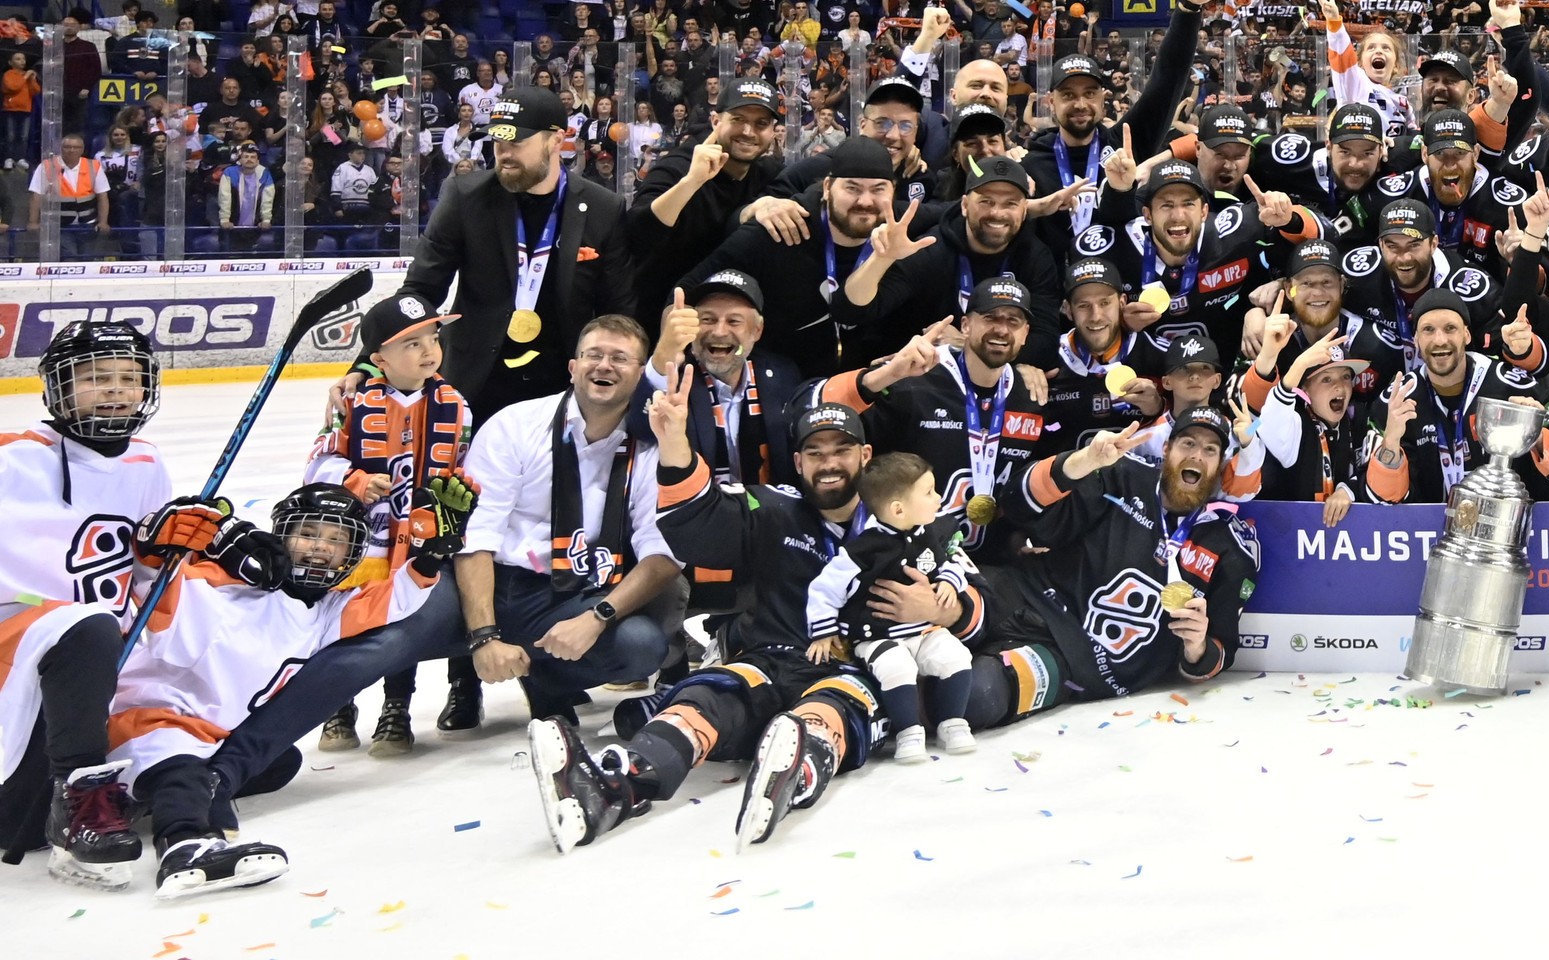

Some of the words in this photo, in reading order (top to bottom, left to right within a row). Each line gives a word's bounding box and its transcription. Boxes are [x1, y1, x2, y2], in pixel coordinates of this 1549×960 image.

[103, 83, 122, 99] A
[130, 83, 158, 100] 12
[48, 266, 85, 275] TIPOS
[110, 265, 147, 274] TIPOS
[169, 264, 206, 273] TIPOS
[229, 263, 265, 272] TIPOS
[289, 262, 324, 271] TIPOS
[919, 420, 963, 430] PANDA-KOŠICE
[321, 500, 347, 508] CCM
[1297, 528, 1434, 560] MAJST
[1314, 634, 1379, 649] ŠKODA
